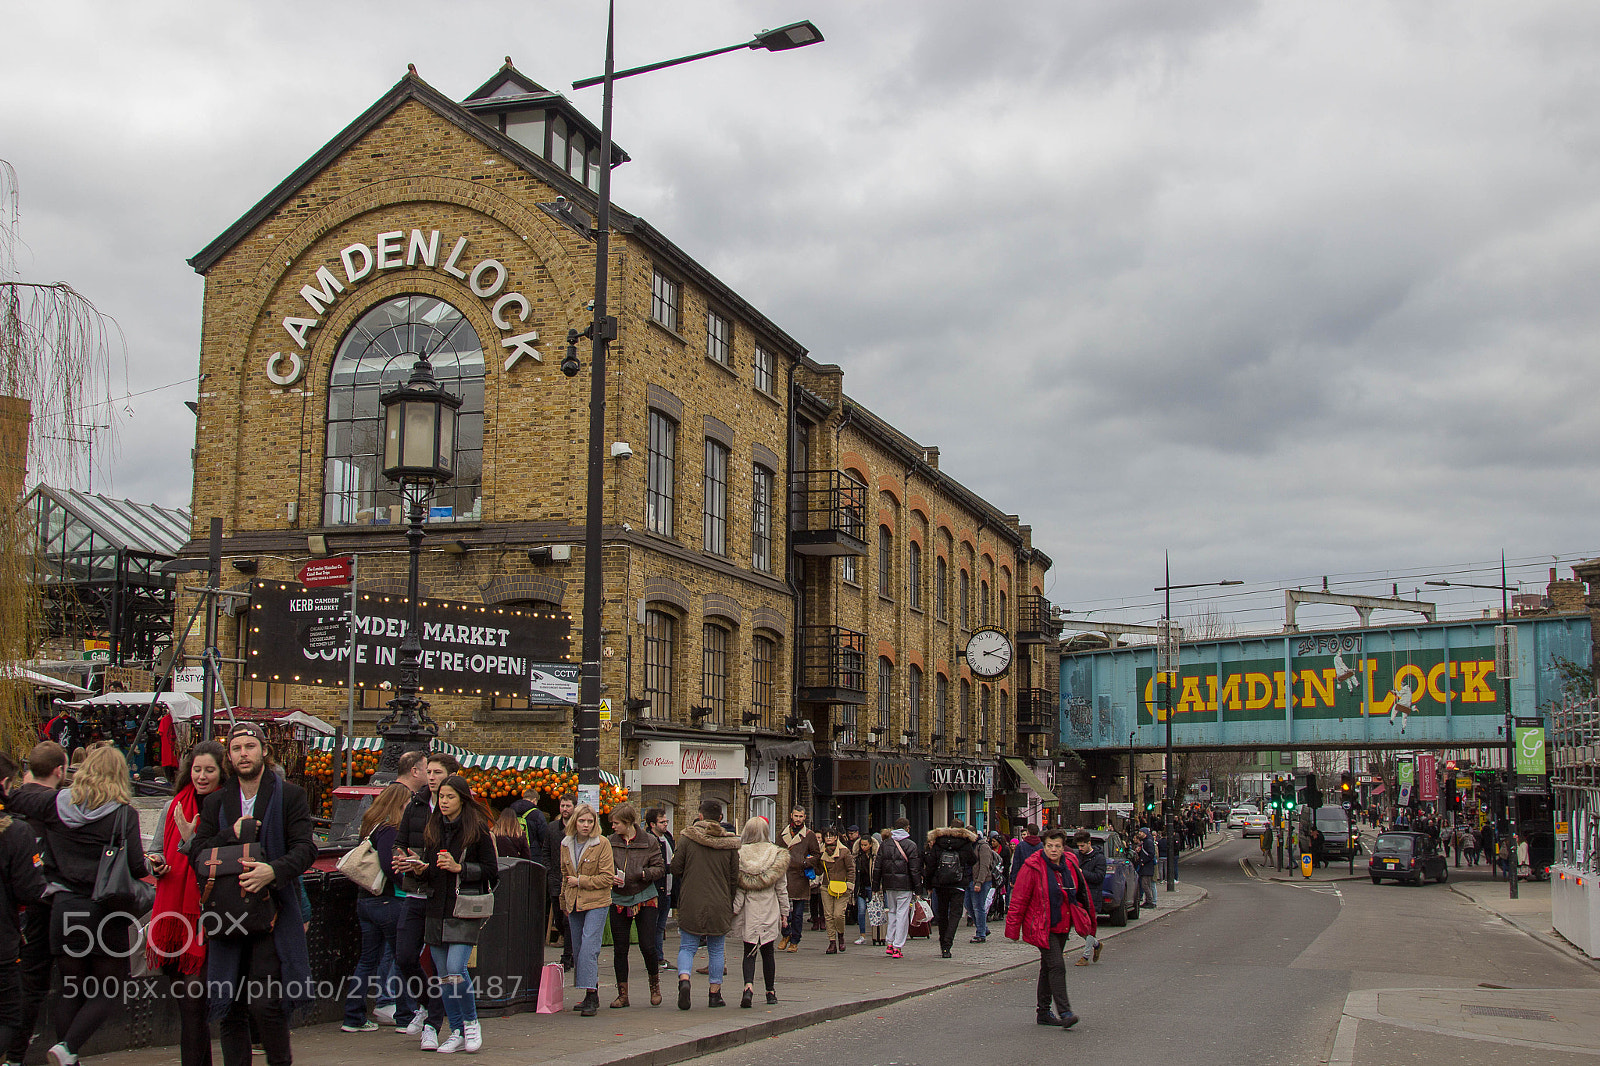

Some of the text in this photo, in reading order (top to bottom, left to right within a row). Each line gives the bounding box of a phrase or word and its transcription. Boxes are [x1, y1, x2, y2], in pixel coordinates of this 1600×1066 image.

[266, 229, 544, 385] CAMDEN LOCK
[290, 598, 313, 612] KERB
[317, 615, 510, 647] MDE MARKET
[375, 646, 396, 666] IN
[176, 674, 204, 682] EAST YA
[554, 670, 577, 678] CCTV
[1144, 668, 1337, 722] CAMDEN
[1358, 658, 1497, 716] LOCK
[642, 758, 674, 766] Cath Kidston
[682, 749, 696, 774] Cath
[694, 749, 717, 774] Kidston
[875, 762, 911, 789] GANDYS
